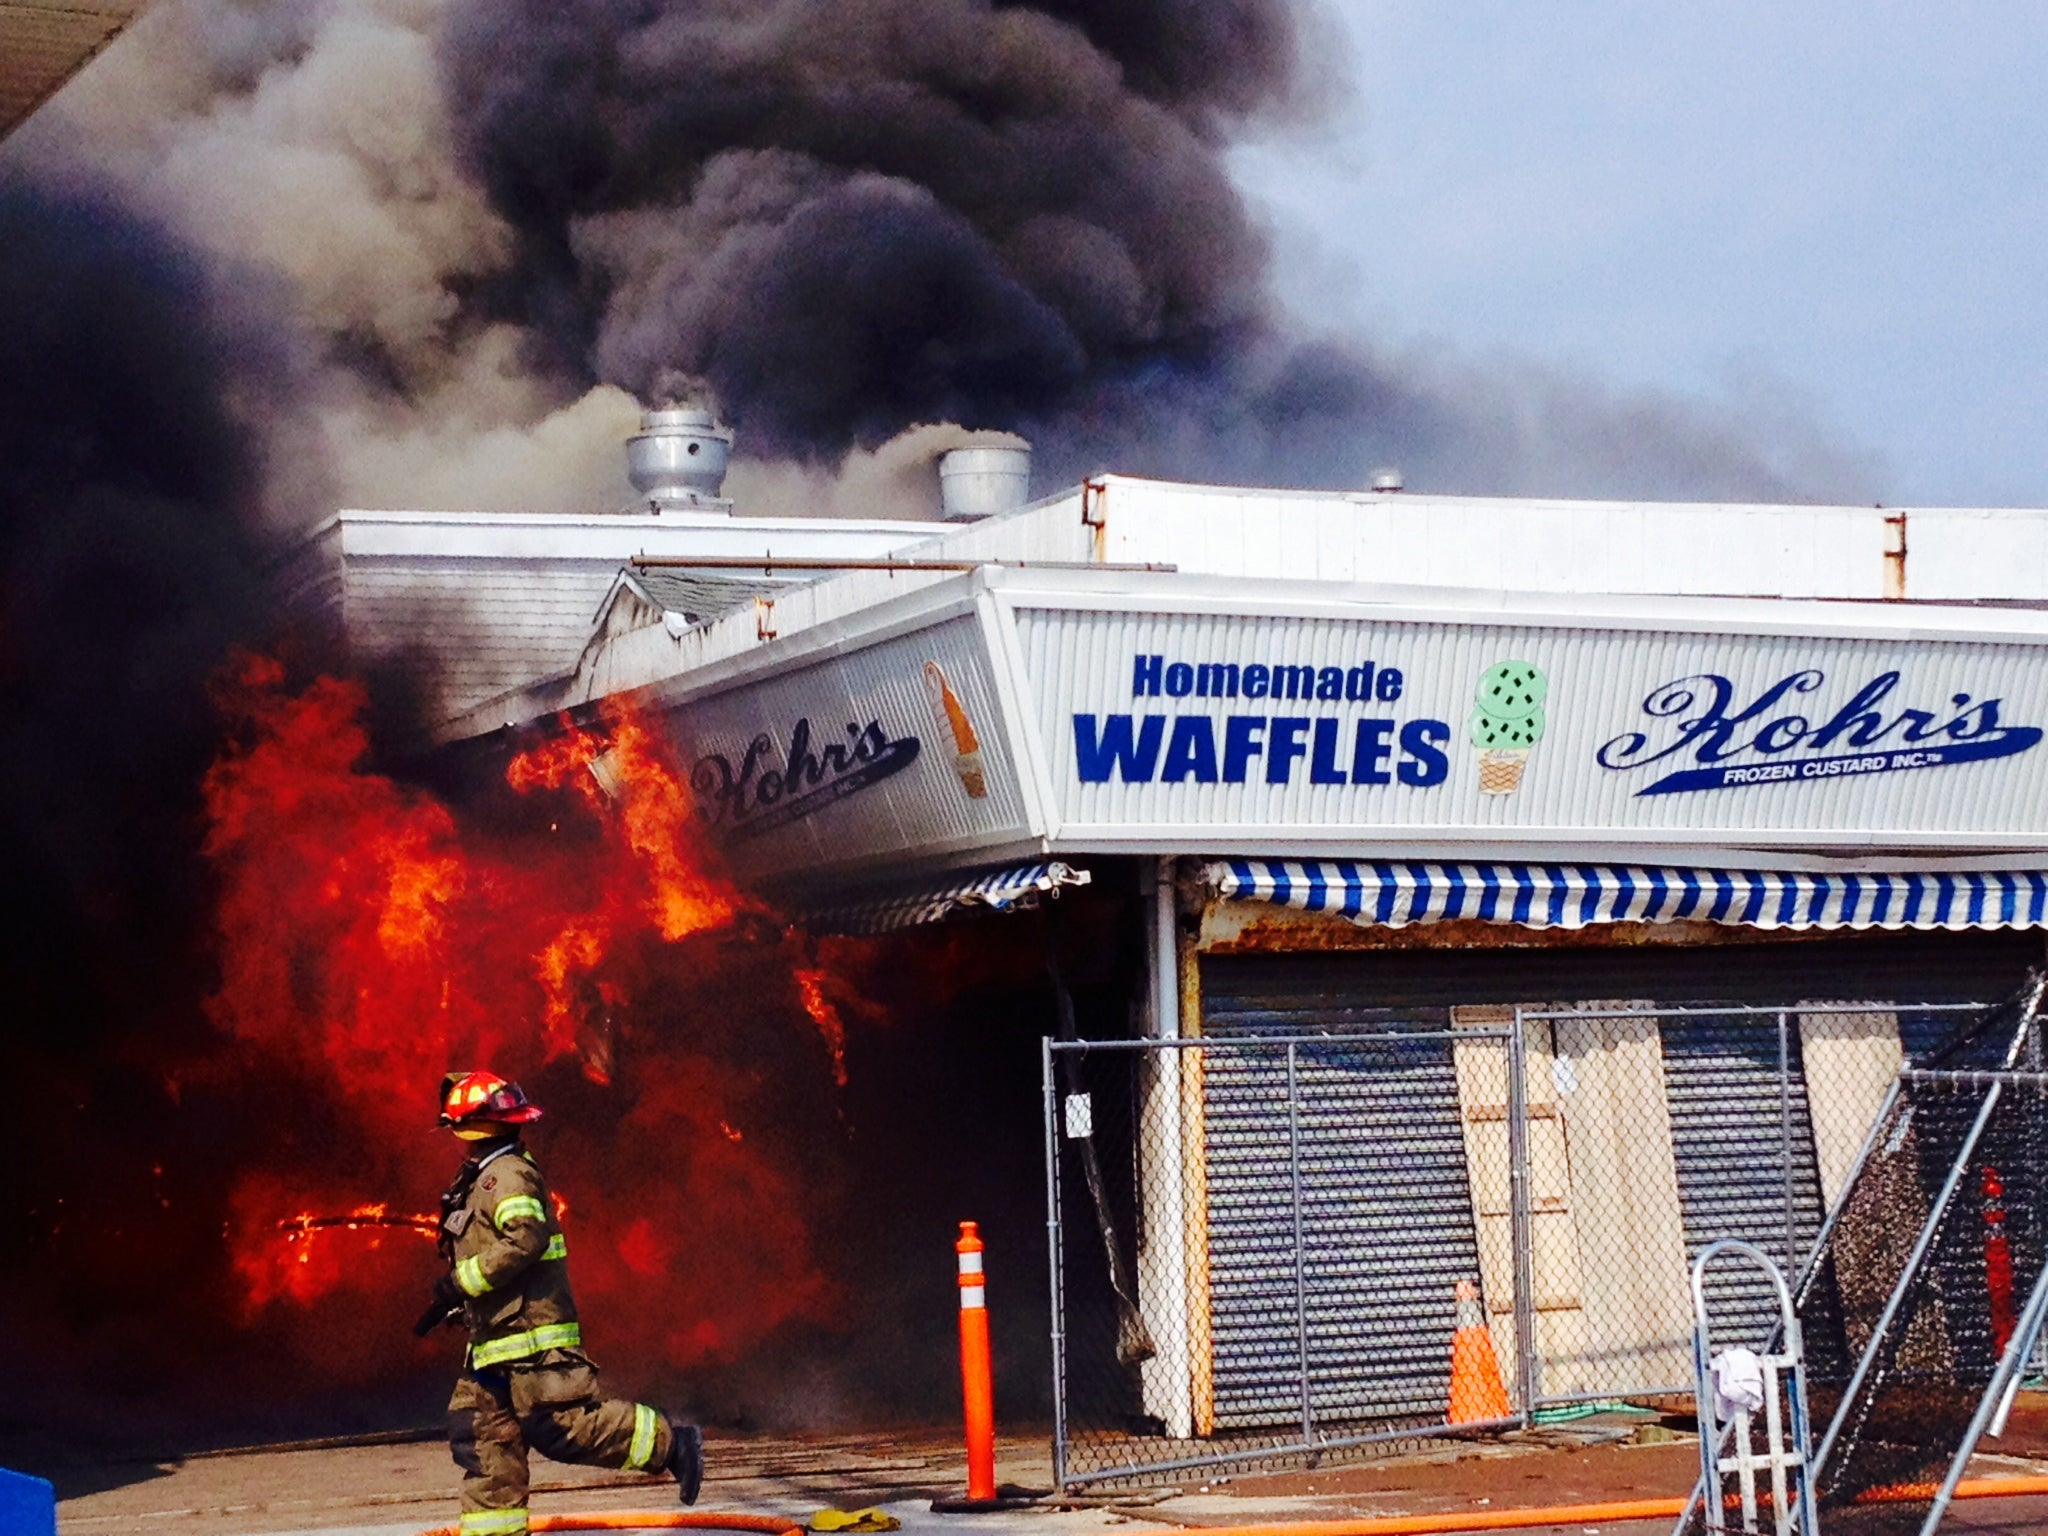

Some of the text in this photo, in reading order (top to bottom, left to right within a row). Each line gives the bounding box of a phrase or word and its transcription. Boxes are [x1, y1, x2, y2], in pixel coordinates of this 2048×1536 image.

[1133, 655, 1403, 701] Homemade
[1597, 669, 2004, 769] Kohr's
[1073, 714, 1451, 786] WAFFLES
[1723, 765, 1797, 784] FROZEN
[1802, 756, 1886, 777] CUSTARD
